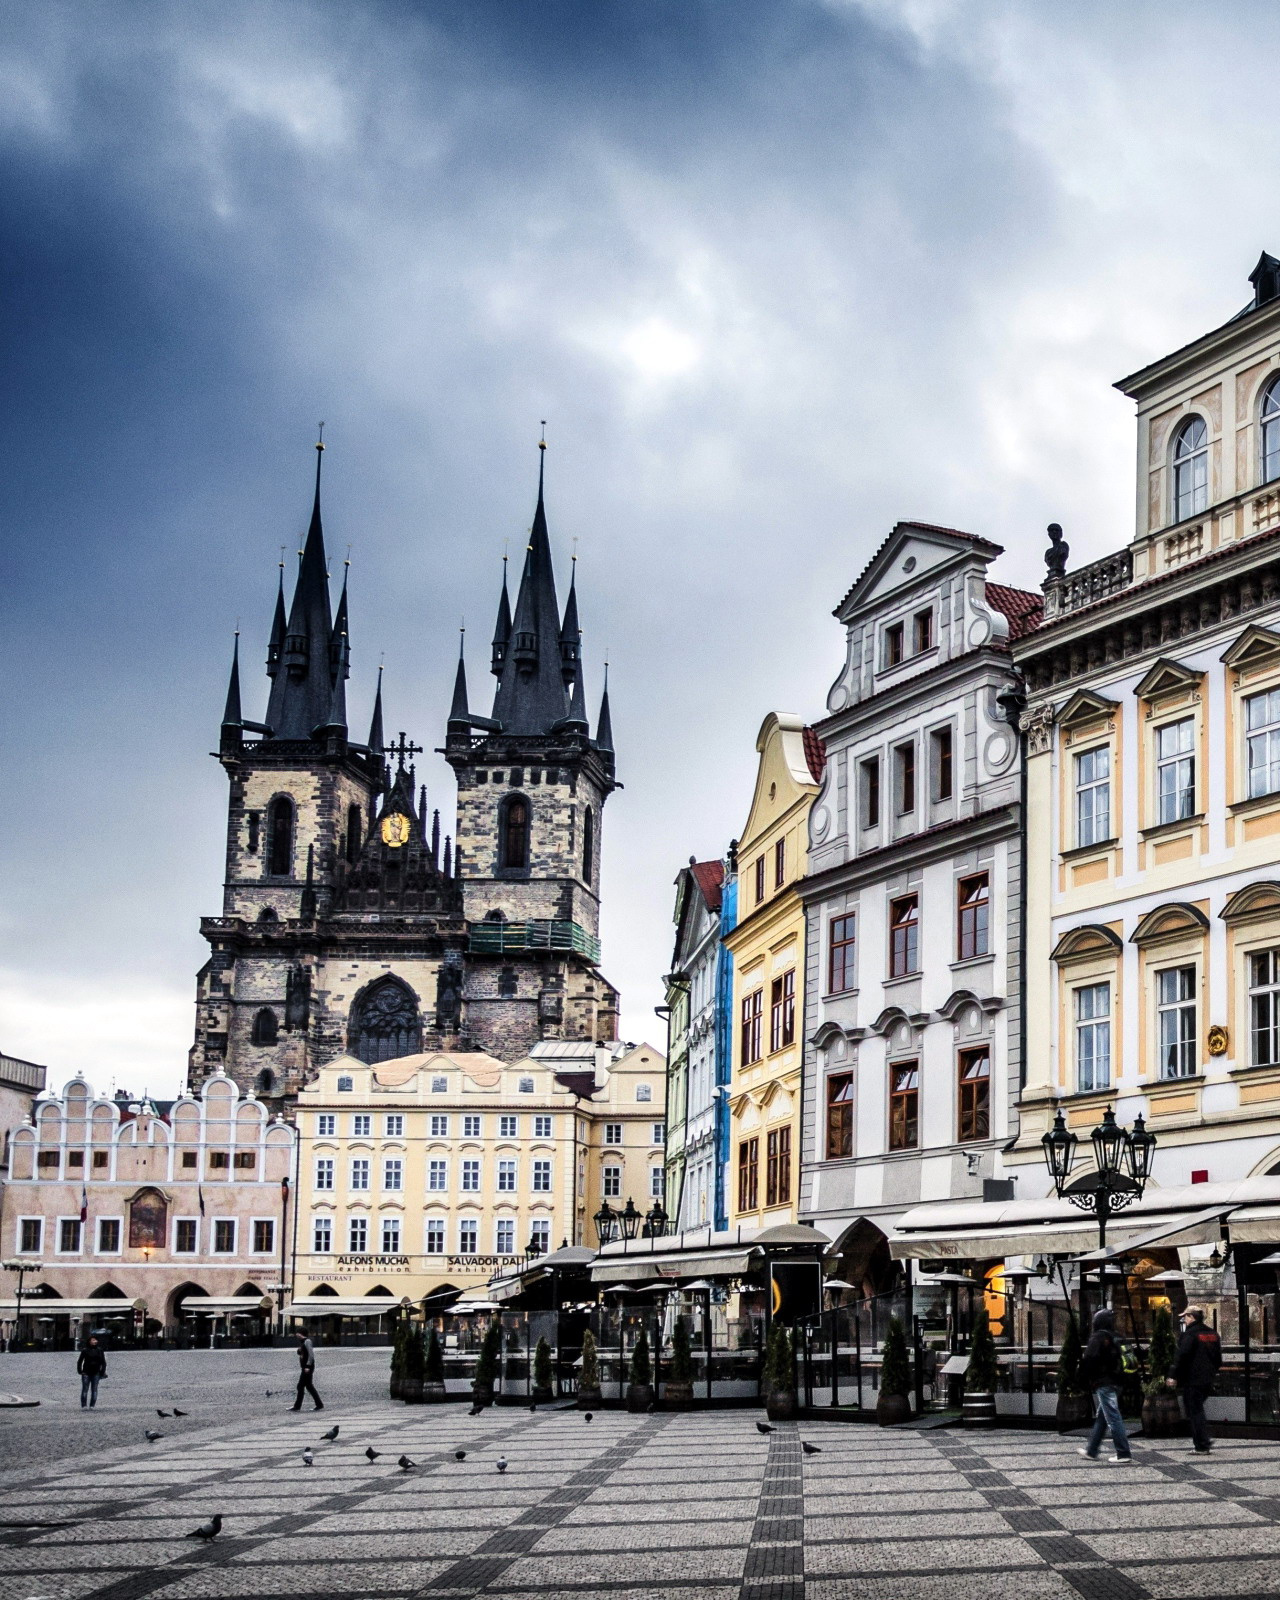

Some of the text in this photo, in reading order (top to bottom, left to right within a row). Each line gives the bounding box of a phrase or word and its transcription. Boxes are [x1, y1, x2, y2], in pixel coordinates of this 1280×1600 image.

[940, 1245, 959, 1256] PASTA
[337, 1256, 409, 1265] ALFONS MUCHA
[448, 1256, 499, 1266] SALVADOR
